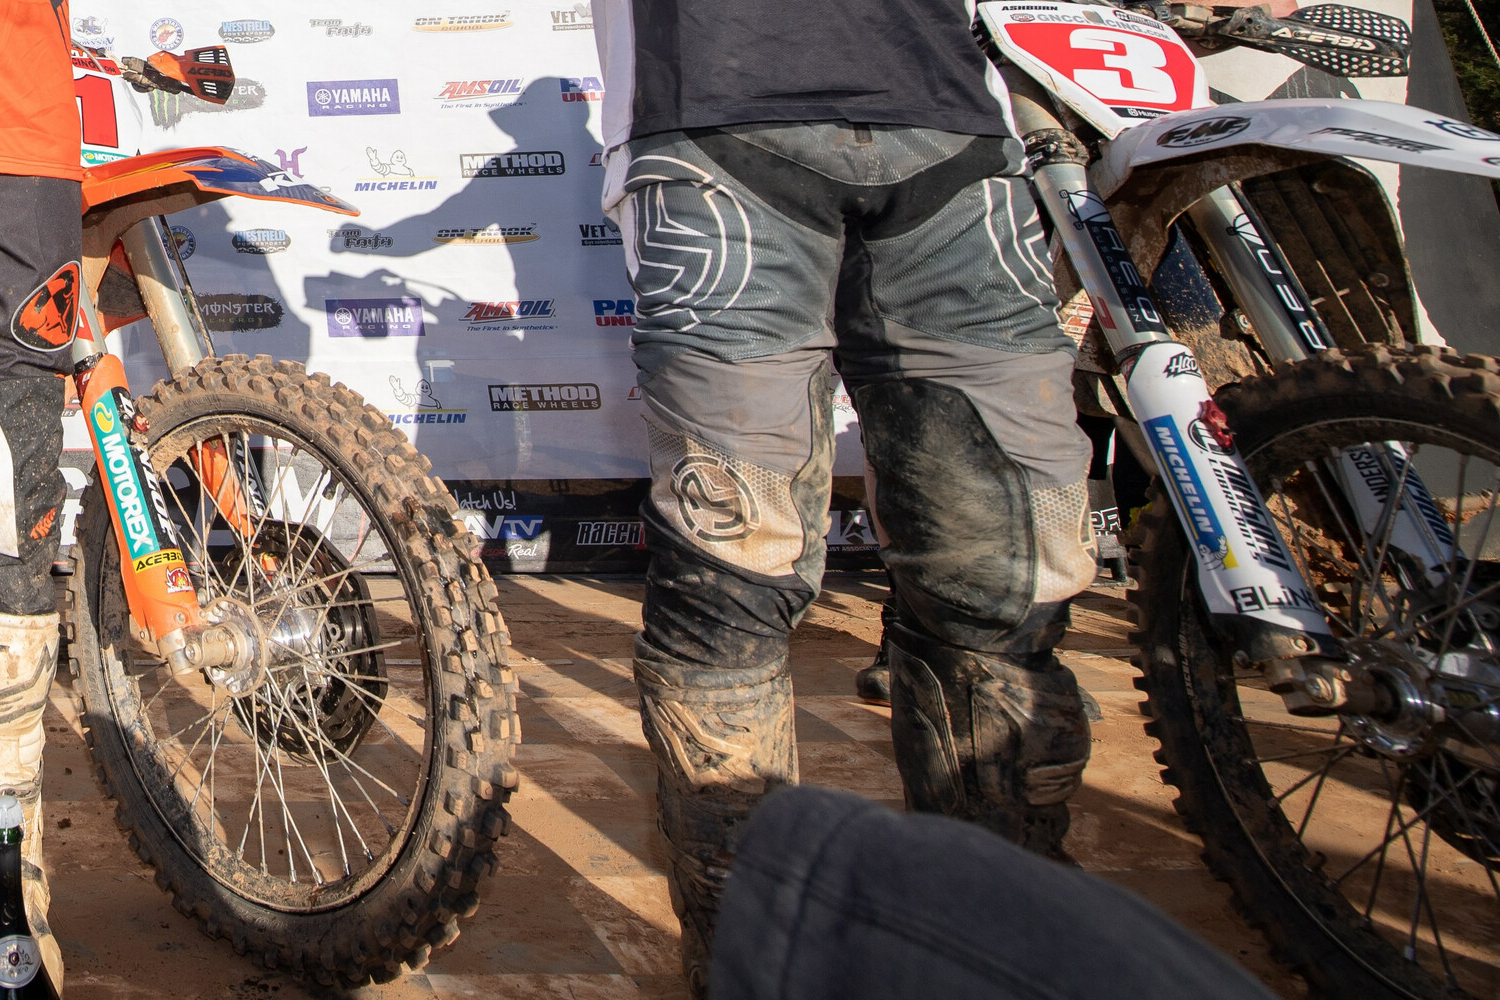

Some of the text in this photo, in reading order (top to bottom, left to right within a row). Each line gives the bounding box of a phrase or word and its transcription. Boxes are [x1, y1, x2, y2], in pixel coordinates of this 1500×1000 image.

[222, 20, 271, 32] WESTFIELD
[1069, 28, 1178, 105] 3
[332, 87, 391, 103] YAMAHA
[440, 77, 522, 97] AMSOIL
[1156, 117, 1251, 145] FMF
[462, 153, 563, 169] METHOD
[463, 166, 563, 177] RACE WHEELS
[354, 180, 437, 191] MICHELIN
[235, 229, 286, 242] WESTFIELD
[352, 308, 414, 324] YAMAHA
[464, 300, 556, 321] AMSOIL
[491, 385, 598, 401] METHOD
[493, 399, 598, 410] RACE WHEELS
[1154, 426, 1214, 534] MICHELIN
[101, 431, 155, 553] MOTOREX
